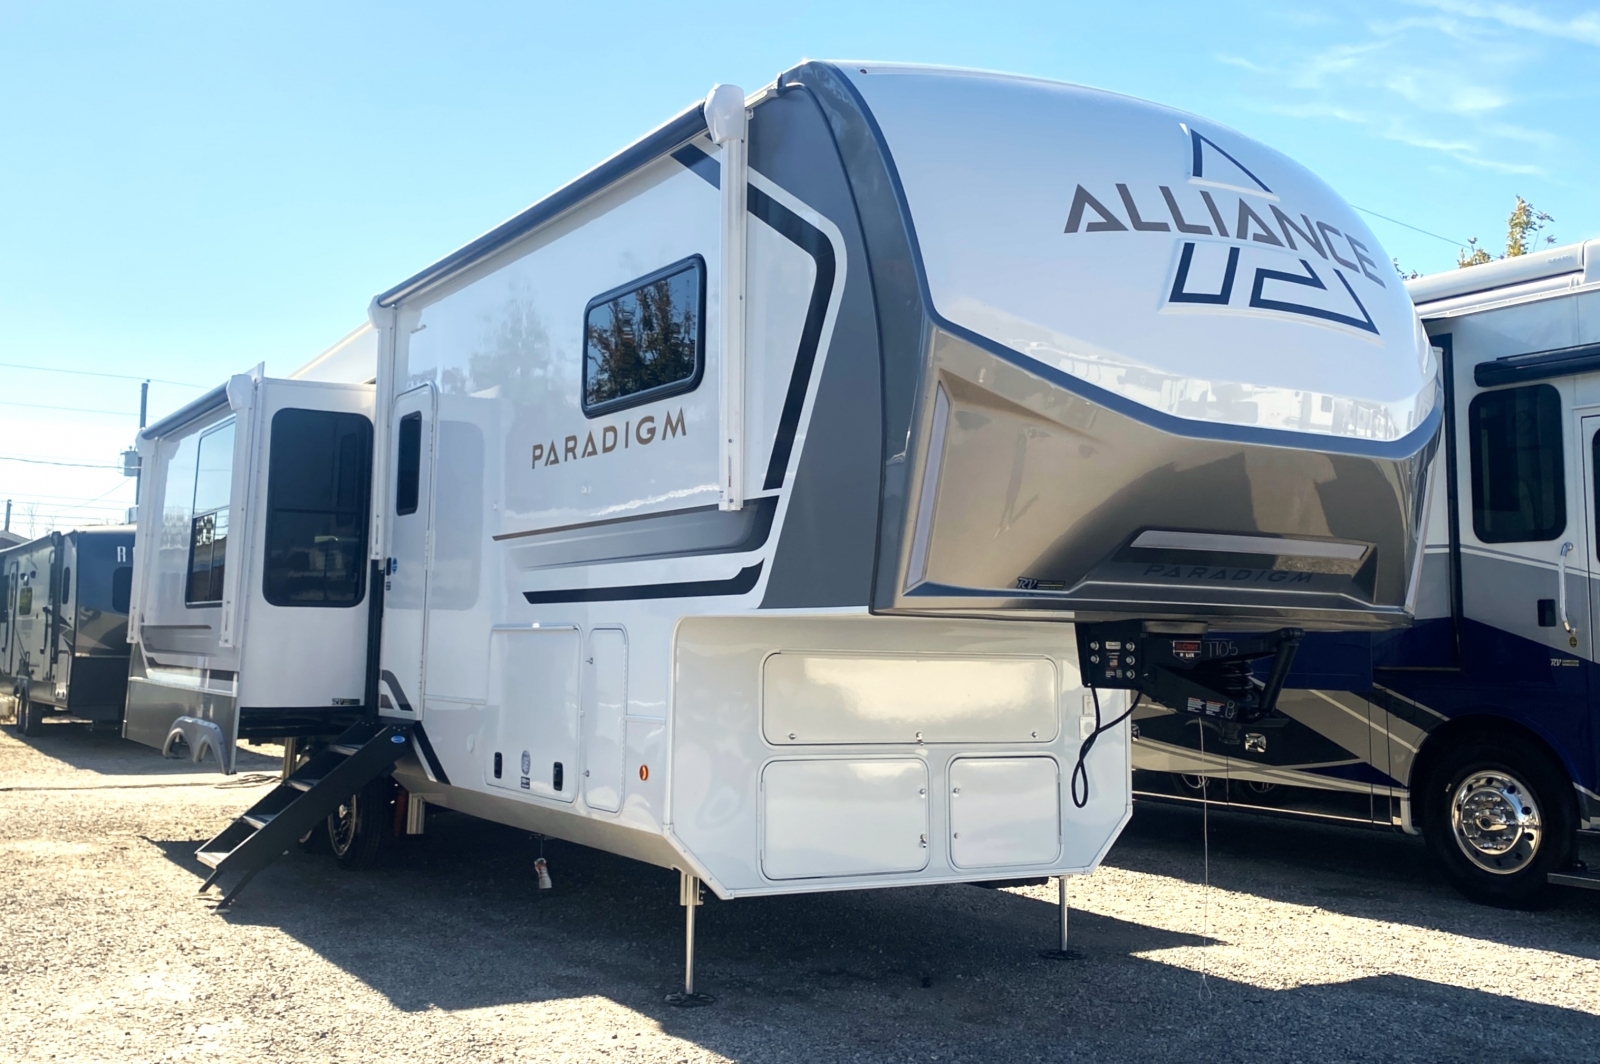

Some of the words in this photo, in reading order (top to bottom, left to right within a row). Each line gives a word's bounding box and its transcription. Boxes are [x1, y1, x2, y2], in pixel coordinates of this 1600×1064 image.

[1064, 183, 1387, 290] ALLIANCE
[531, 407, 687, 470] PARADIGM
[1018, 577, 1038, 590] RV
[1142, 564, 1314, 584] PARADIGM
